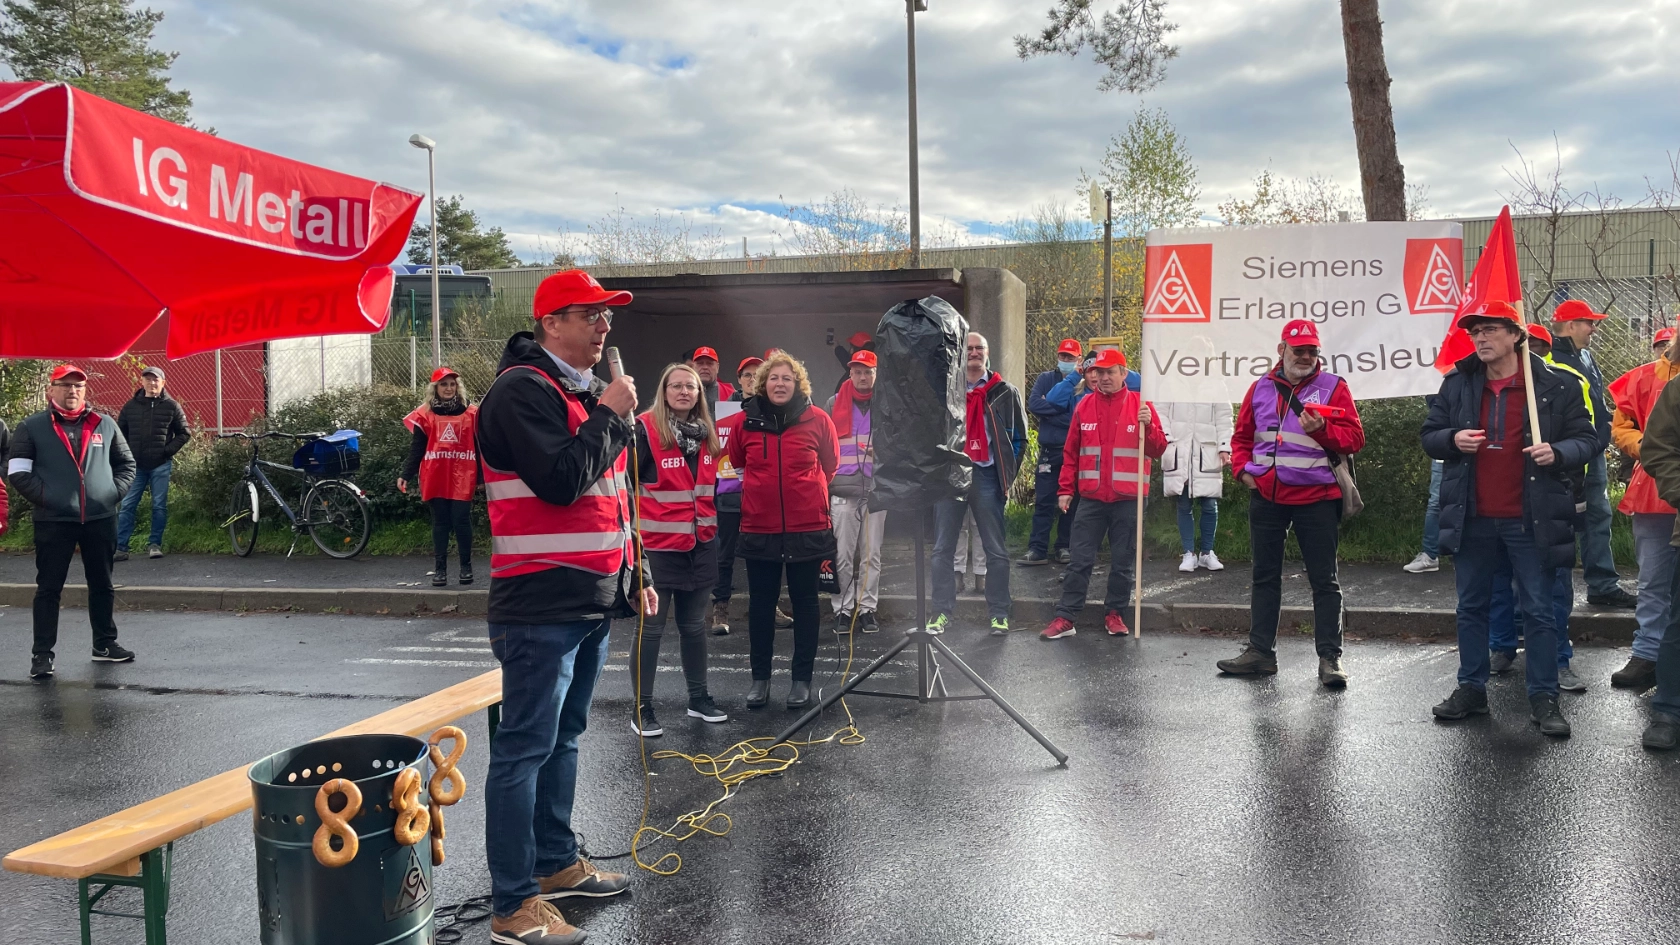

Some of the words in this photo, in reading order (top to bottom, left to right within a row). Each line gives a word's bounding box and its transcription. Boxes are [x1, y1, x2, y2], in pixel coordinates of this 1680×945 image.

[133, 137, 188, 211] IG
[209, 163, 366, 249] Metall
[1242, 256, 1383, 280] Siemens
[1218, 296, 1366, 324] Erlangen
[1376, 292, 1402, 315] G
[1149, 343, 1442, 377] Vertransleu
[1080, 422, 1098, 431] GEBT
[1126, 424, 1136, 433] 8!
[424, 450, 476, 461] Warnstreik
[661, 456, 685, 469] GEBT
[703, 454, 713, 465] 8!
